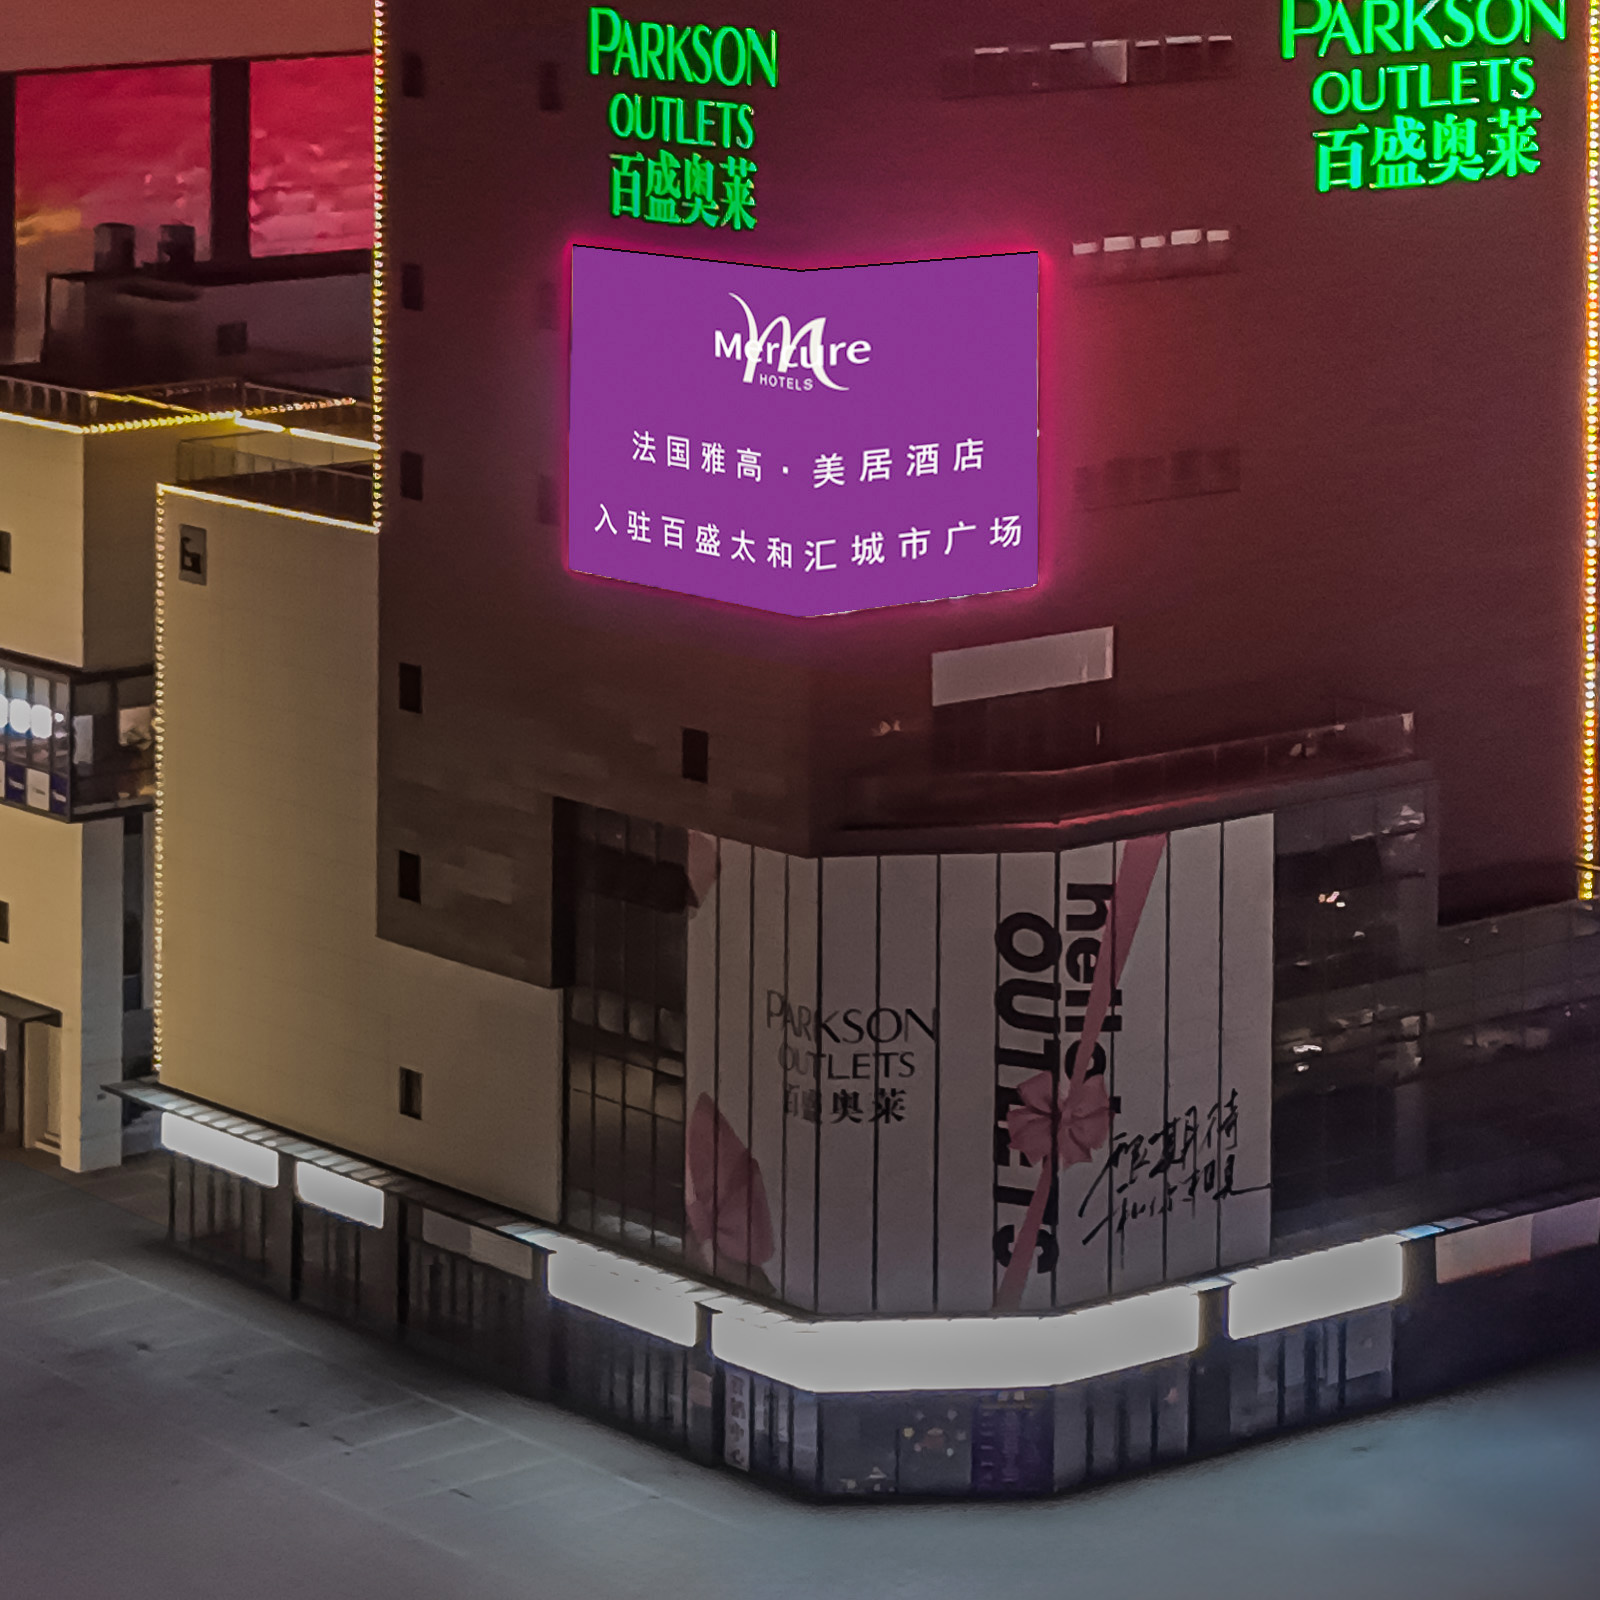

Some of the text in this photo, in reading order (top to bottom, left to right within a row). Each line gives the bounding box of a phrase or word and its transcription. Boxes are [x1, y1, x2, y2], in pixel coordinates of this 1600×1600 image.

[589, 7, 778, 87] PARKSON
[1312, 57, 1537, 115] OUTLETS
[609, 93, 755, 149] OUTLETS
[1312, 107, 1542, 193] 百盛奥莱
[609, 149, 757, 231] 百盛奥莱
[760, 373, 814, 391] HOTELS
[594, 503, 1023, 573] 入驻百盛太和汇城市广场
[766, 990, 938, 1044] PARKSON
[778, 1042, 916, 1080] OUTLETS
